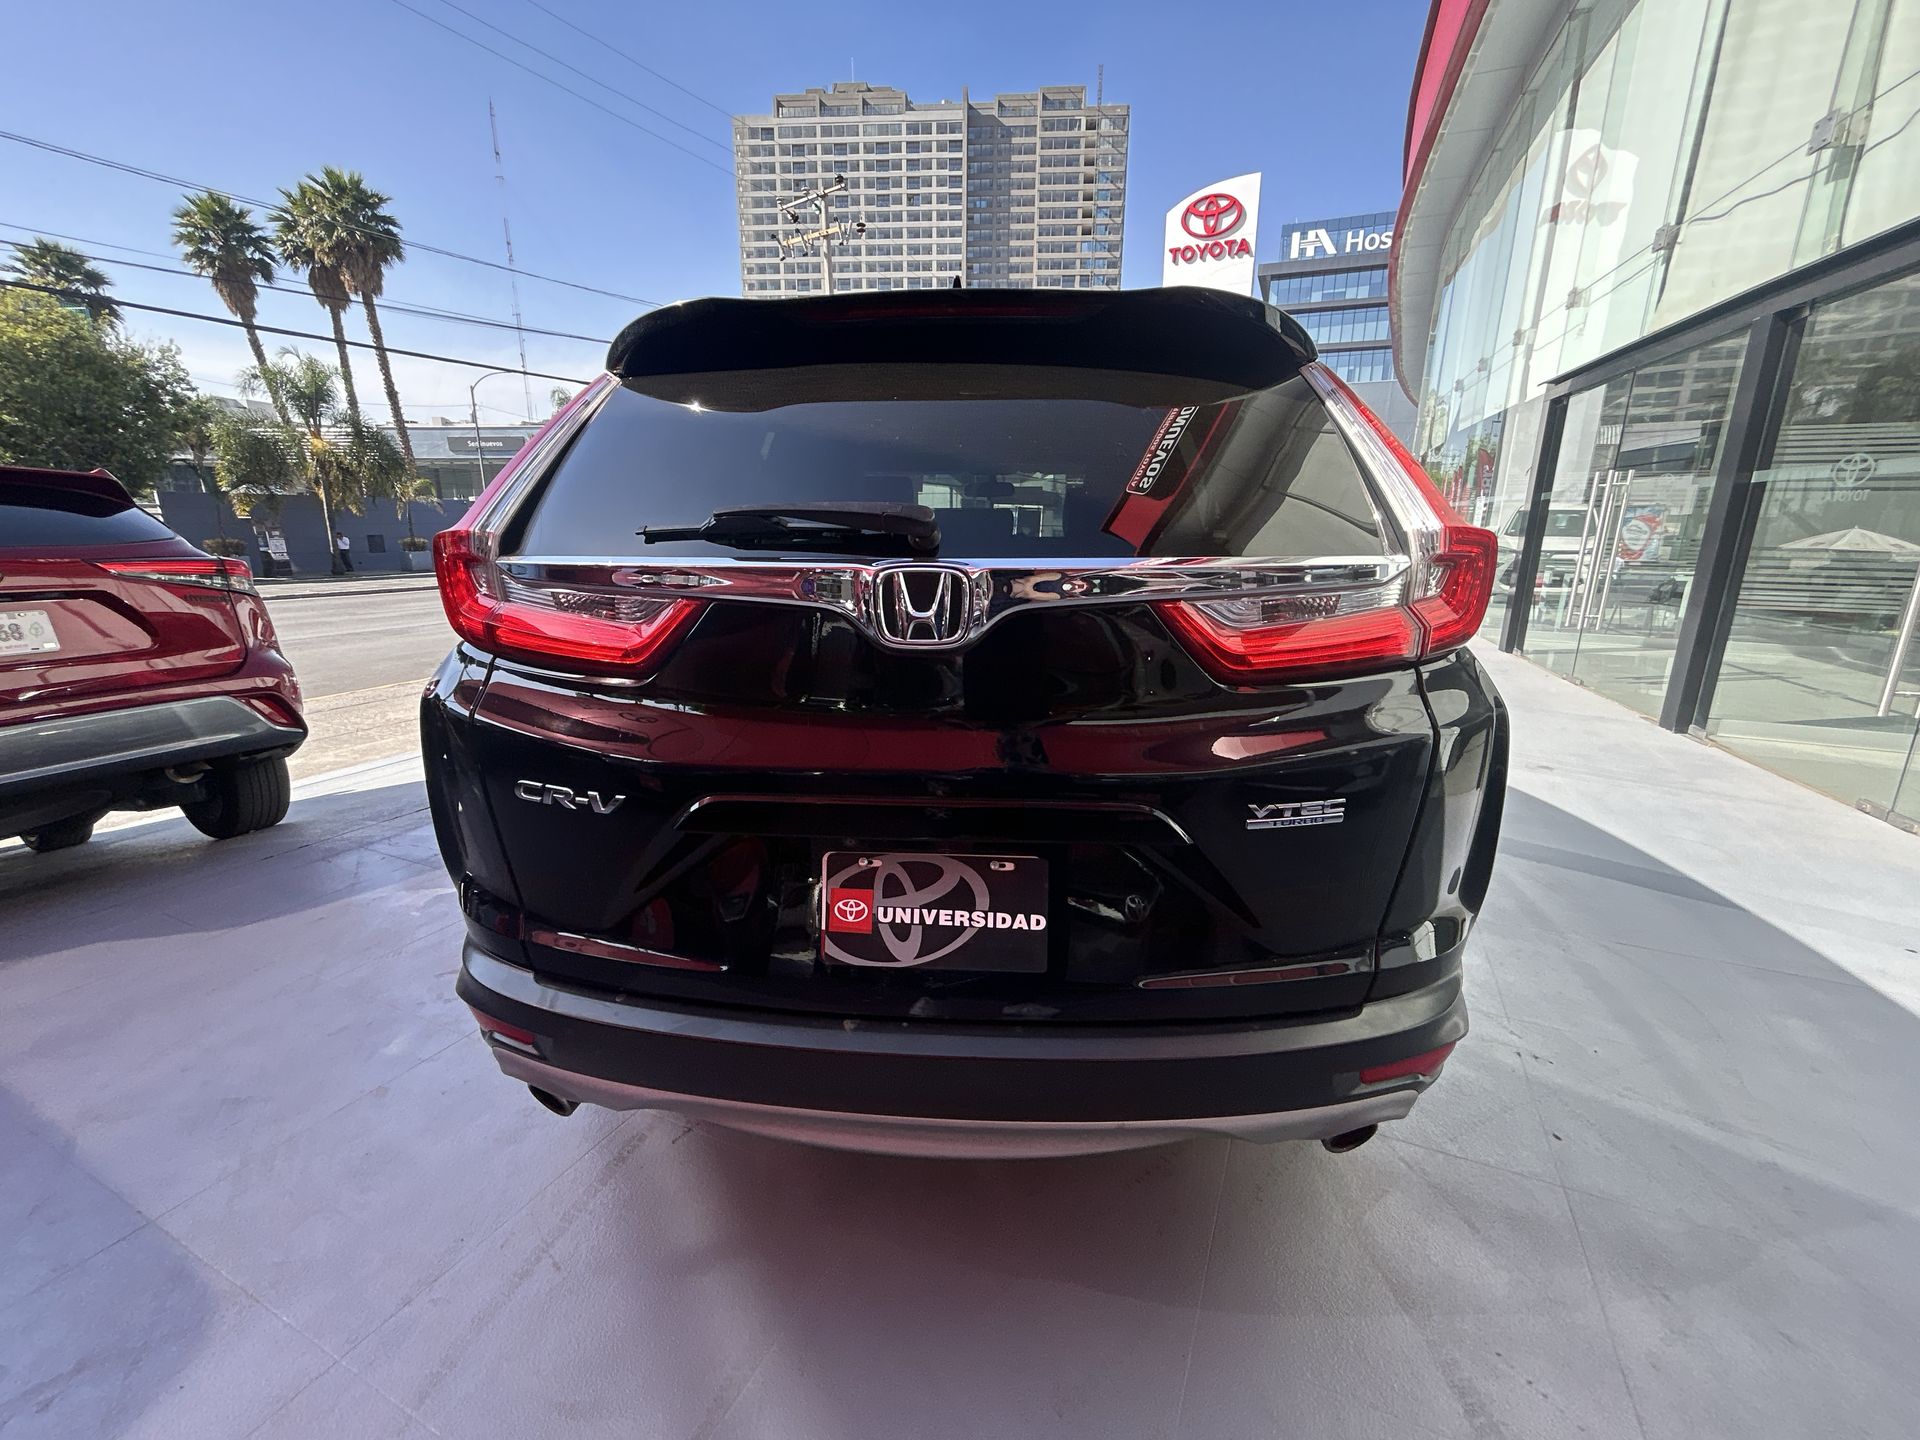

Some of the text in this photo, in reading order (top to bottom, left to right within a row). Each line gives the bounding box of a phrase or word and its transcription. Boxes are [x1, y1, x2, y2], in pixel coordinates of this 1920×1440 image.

[1169, 238, 1252, 265] TOYOTA
[514, 780, 626, 814] CR-V
[1248, 798, 1346, 819] VTEC
[1269, 816, 1325, 827] TURBO
[877, 906, 1047, 931] UNIVERSIDAD
